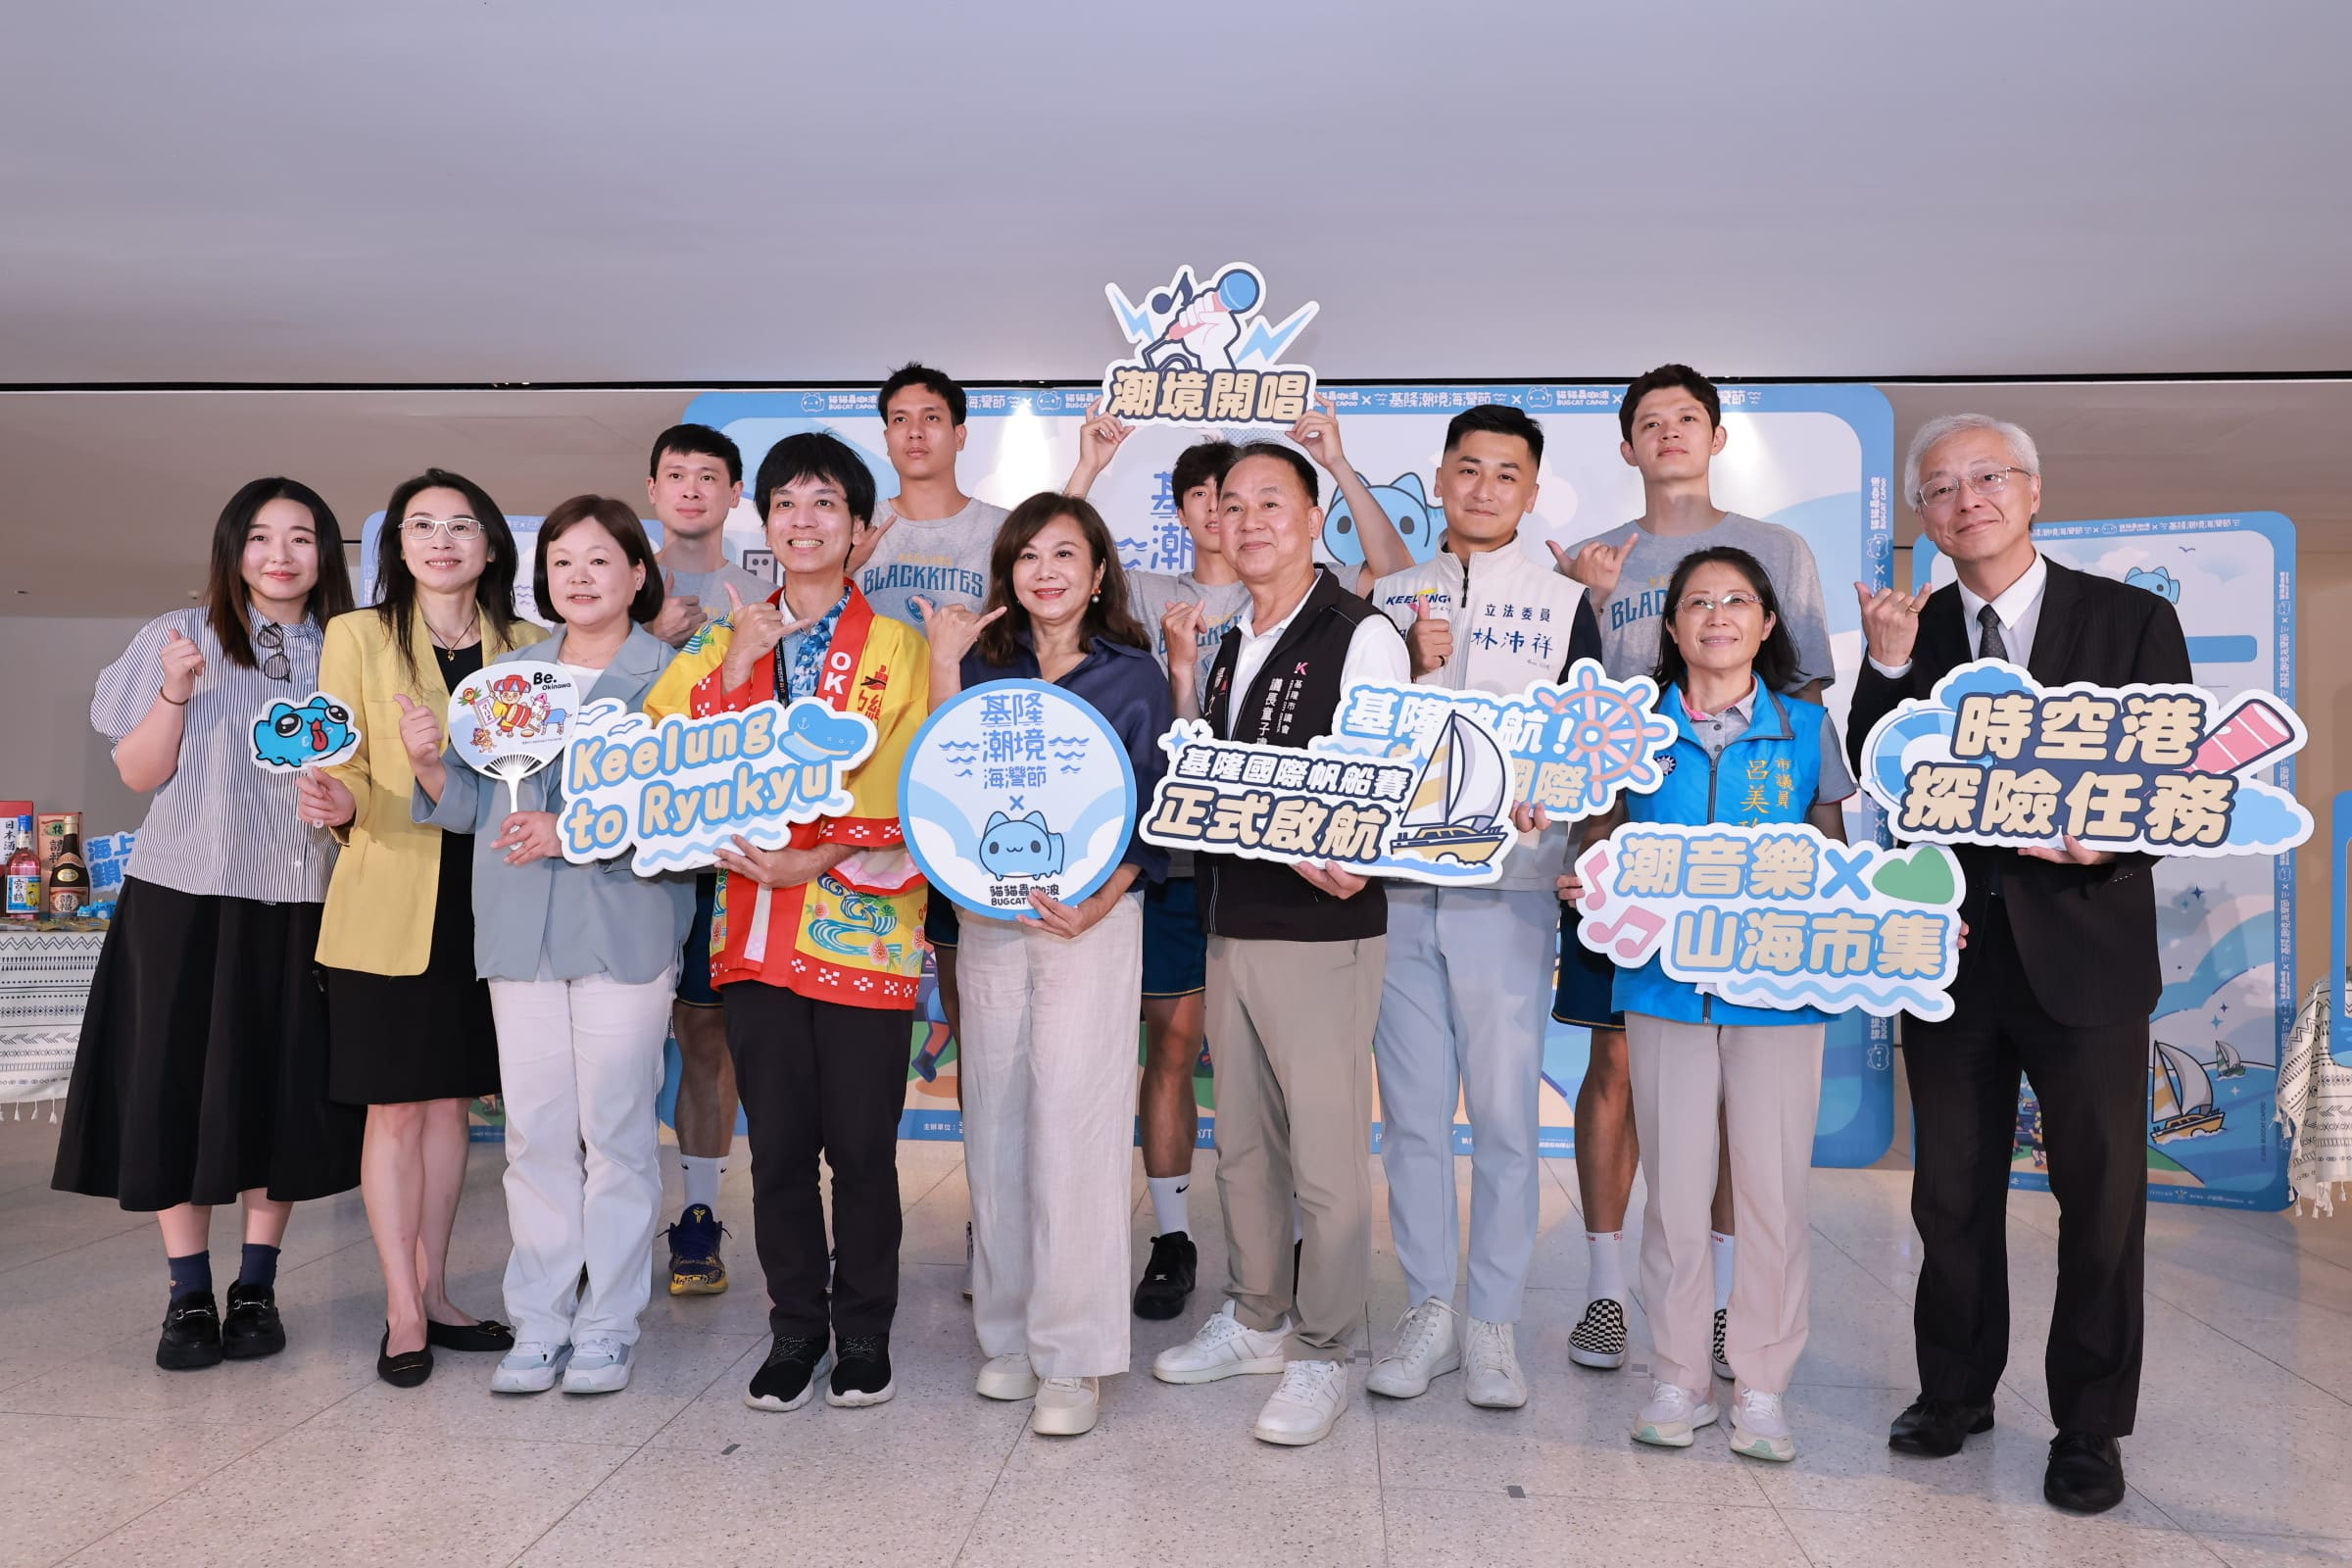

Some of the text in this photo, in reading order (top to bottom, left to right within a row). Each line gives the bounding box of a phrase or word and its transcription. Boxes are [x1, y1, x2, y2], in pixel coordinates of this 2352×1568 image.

[1108, 368, 1310, 421] 潮境開唱
[1389, 391, 1492, 409] 基隆潮境海灣節
[863, 564, 984, 598] BLACKKITES
[1484, 603, 1550, 622] 立法委員
[1470, 626, 1553, 660] 林沛祥
[532, 671, 558, 686] Be.
[541, 682, 572, 691] Okinawa
[979, 693, 1045, 726] 基隆
[982, 728, 1047, 762] 潮境
[1953, 695, 2203, 765] 時空港
[571, 710, 773, 792] Keelung
[983, 765, 1047, 790] 海灣節
[1178, 746, 1409, 802] 基隆國際帆船賽
[1775, 758, 1794, 810] 市議員
[567, 762, 828, 850] to Ryukyu
[1903, 766, 2234, 844] 探險任務
[1151, 786, 1388, 860] 正式啟航
[87, 835, 135, 862] 海上
[90, 858, 128, 888] 鎖
[1615, 835, 1816, 899] 潮音樂
[991, 898, 1027, 906] BUGCAT
[1675, 909, 1946, 977] 山海市集
